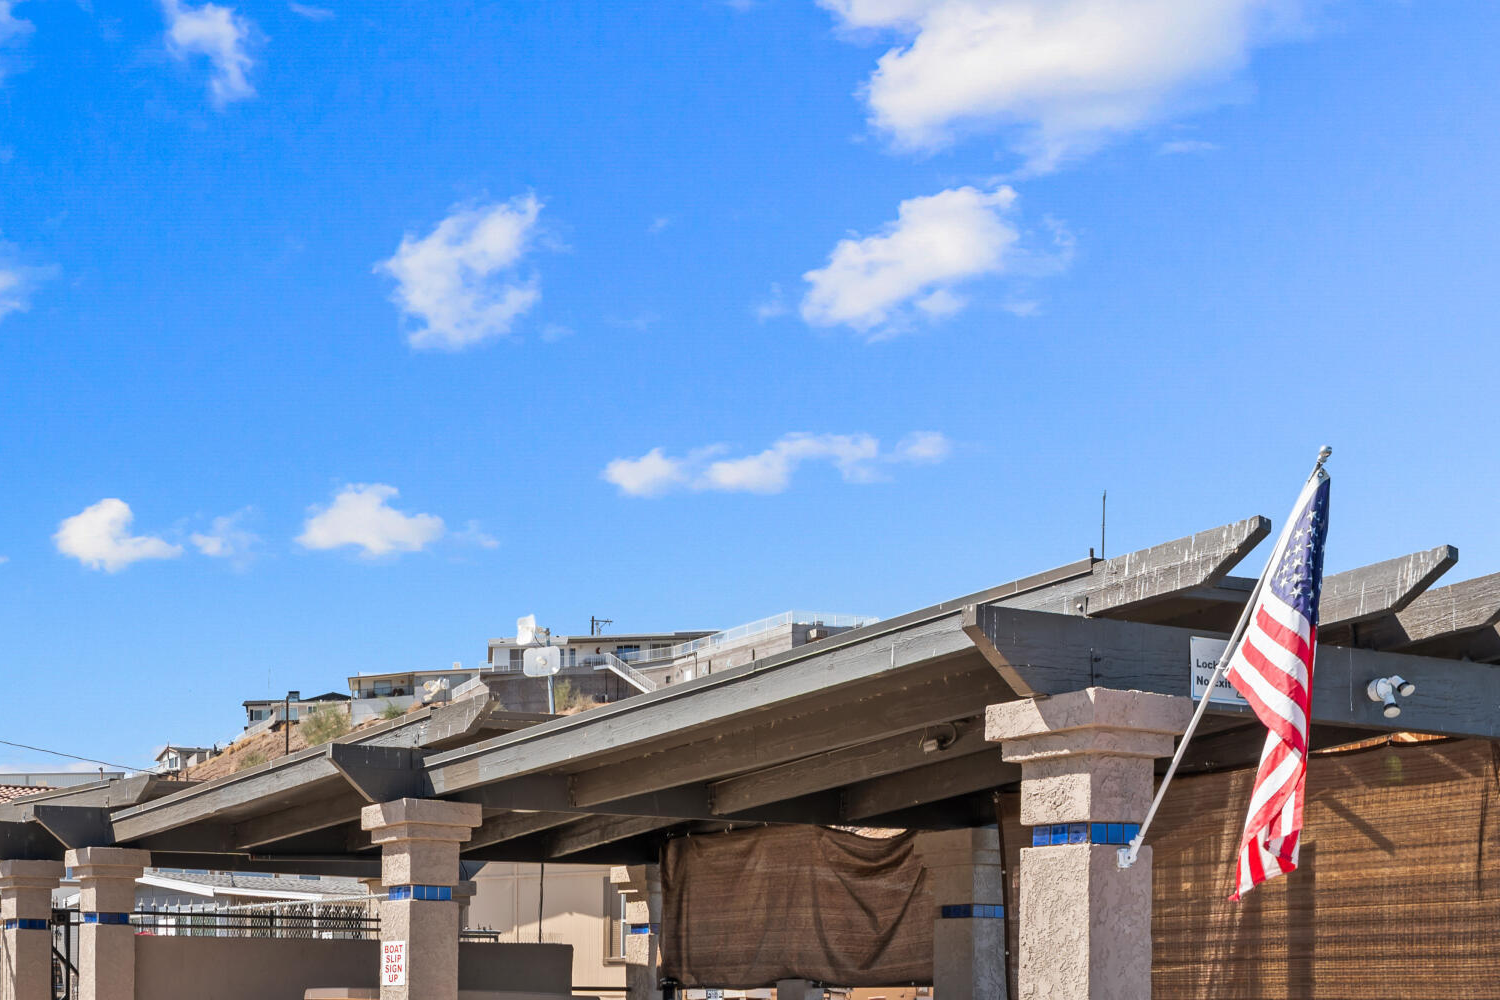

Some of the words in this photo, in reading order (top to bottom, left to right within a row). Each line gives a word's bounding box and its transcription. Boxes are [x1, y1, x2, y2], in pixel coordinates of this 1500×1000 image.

[1196, 675, 1209, 686] No
[384, 944, 403, 954] BOAT
[385, 954, 402, 964] SLIP
[384, 964, 403, 974] SIGN
[388, 974, 399, 983] UP
